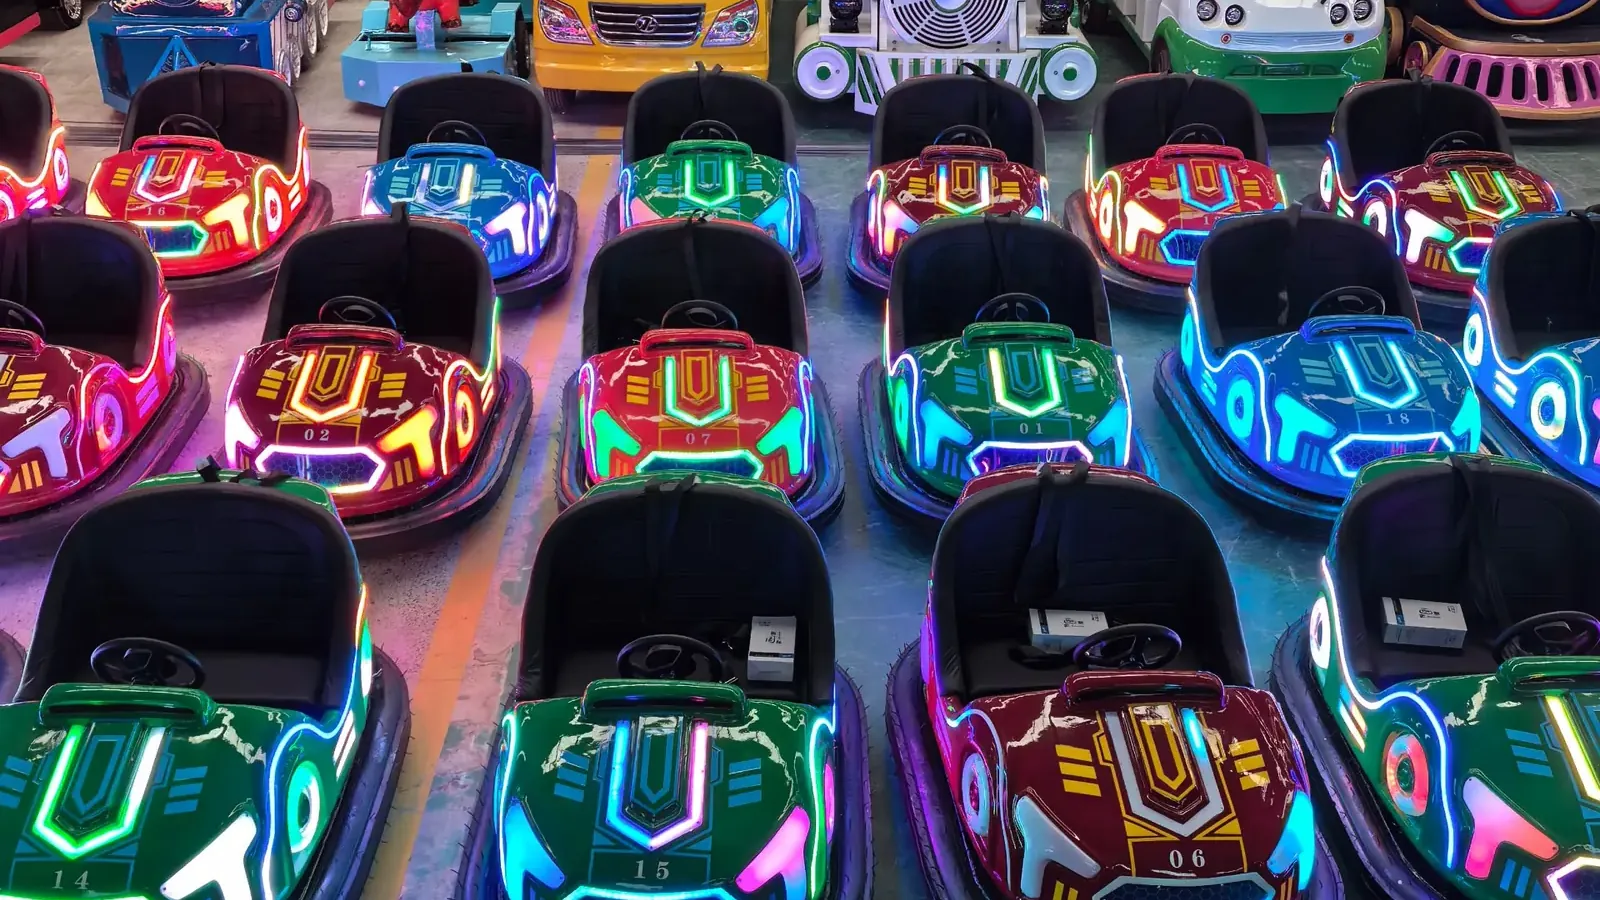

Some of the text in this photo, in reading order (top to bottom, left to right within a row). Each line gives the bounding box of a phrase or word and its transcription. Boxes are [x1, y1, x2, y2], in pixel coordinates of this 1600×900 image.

[1385, 413, 1410, 425] 18
[1019, 423, 1043, 434] 01
[304, 429, 330, 441] 02
[686, 433, 711, 445] 07
[1169, 849, 1205, 868] 06
[634, 860, 669, 879] 15
[52, 870, 89, 889] 14
